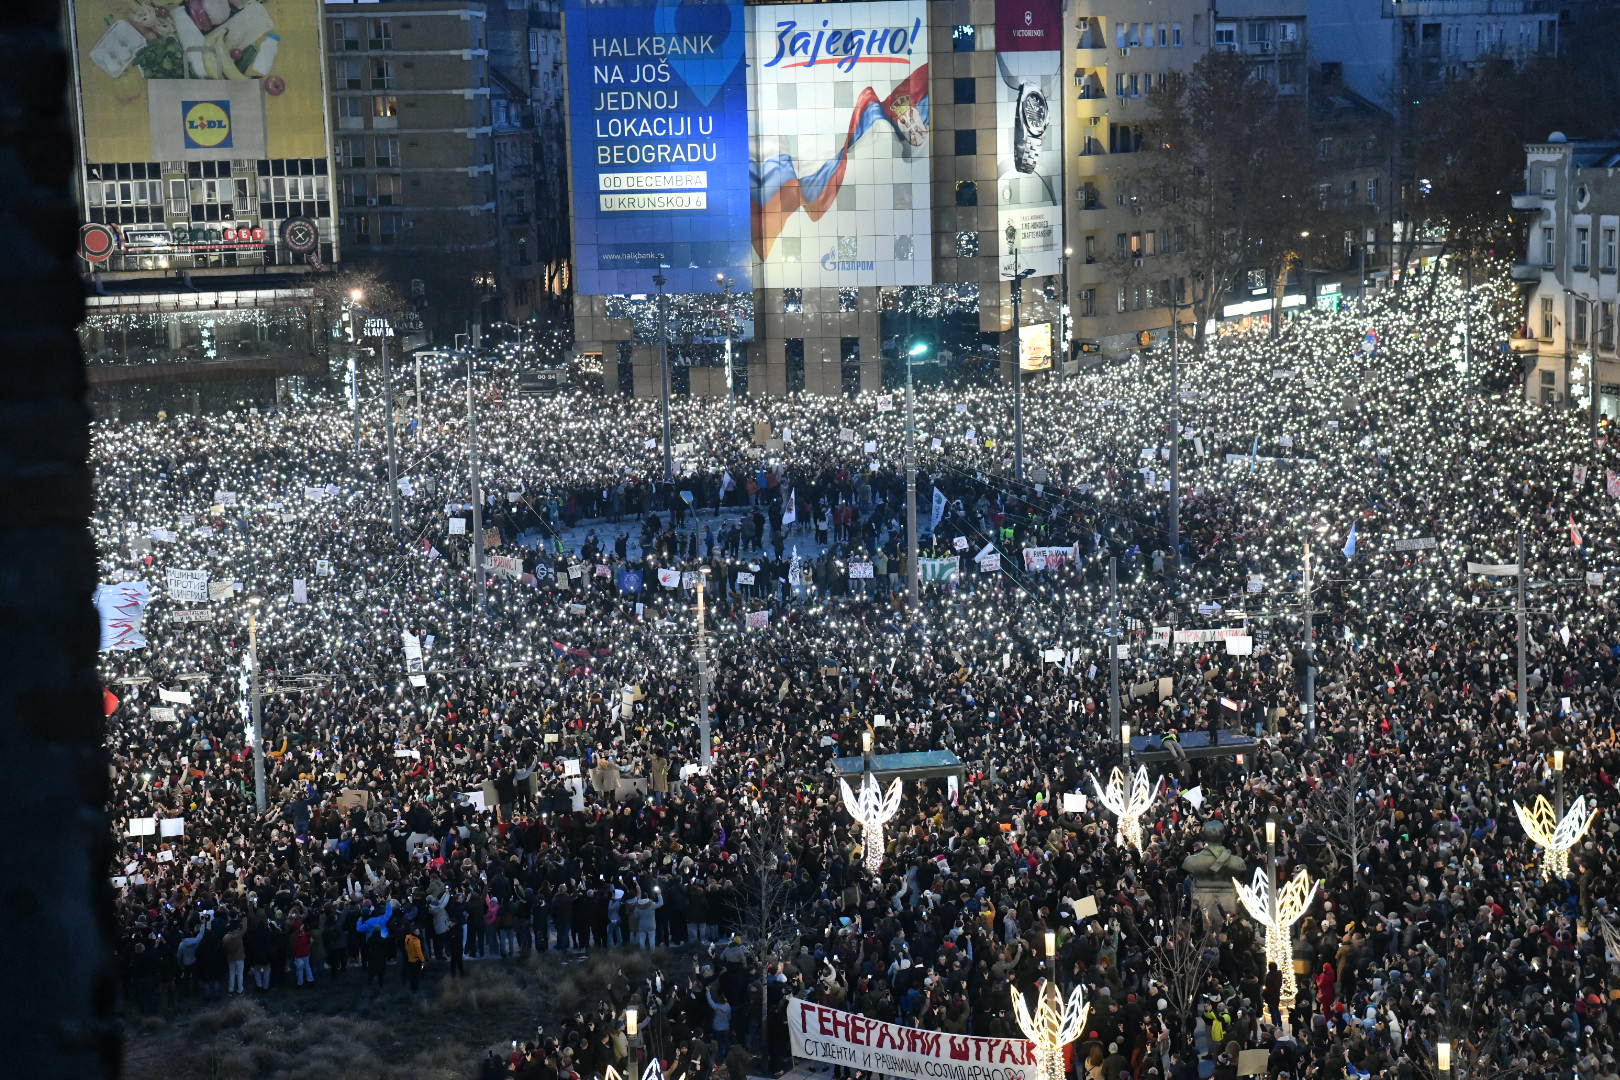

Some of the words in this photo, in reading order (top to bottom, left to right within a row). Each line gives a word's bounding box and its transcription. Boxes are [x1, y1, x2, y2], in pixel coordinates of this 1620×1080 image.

[1012, 29, 1045, 37] VICTORINOX
[592, 35, 715, 57] HALKBANK
[763, 16, 922, 74] Заједно!
[594, 65, 625, 84] NA
[630, 57, 671, 83] JOŠ
[594, 90, 679, 111] JEDNOJ
[596, 116, 692, 138] LOKACIJI
[698, 115, 714, 135] U
[597, 142, 717, 165] BEOGRADU
[603, 176, 622, 188] OD
[626, 174, 704, 188] DECEMBRA
[604, 197, 613, 208] U
[618, 195, 692, 209] KRUNSKOJ
[695, 196, 702, 207] 6
[169, 578, 206, 591] ПРОТИВ
[800, 1002, 942, 1058] ГЕНЕРАЛНИ
[949, 1035, 1038, 1066] ШТРАЈК
[804, 1038, 857, 1063] СТУДЕНТИ
[862, 1052, 871, 1068] И
[874, 1052, 924, 1077] РАДНИЦИ
